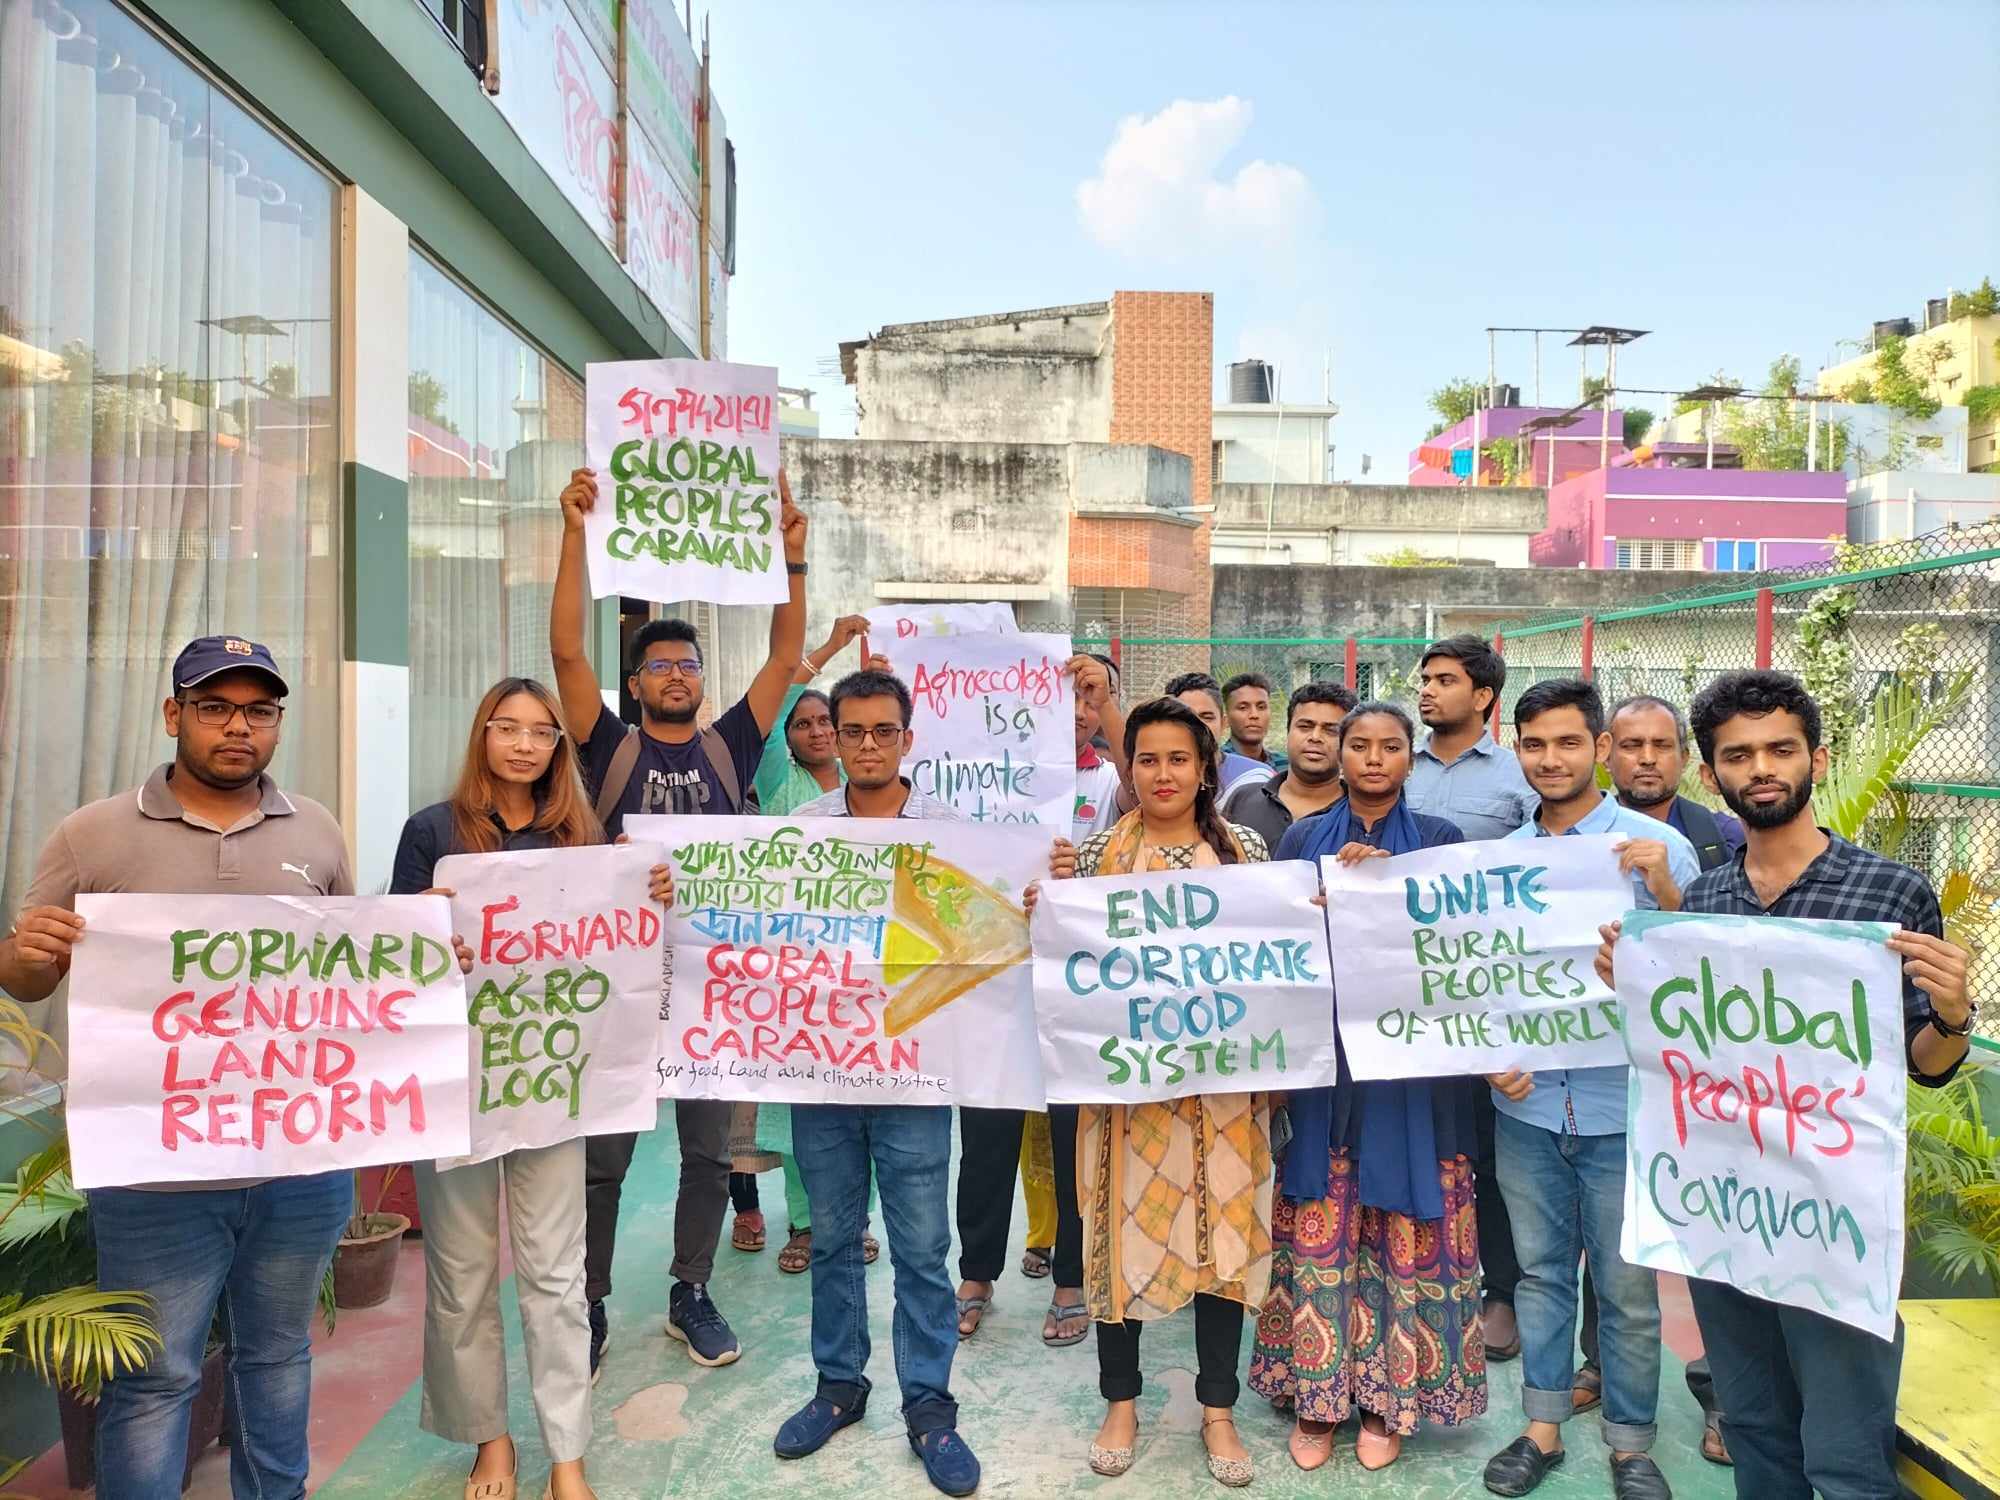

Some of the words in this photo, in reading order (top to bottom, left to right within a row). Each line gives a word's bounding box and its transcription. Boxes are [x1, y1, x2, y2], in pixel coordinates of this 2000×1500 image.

[610, 437, 769, 486] GLOBAL
[607, 527, 772, 573] CARAVAN
[984, 696, 1007, 735] is
[1013, 708, 1036, 734] a
[1105, 882, 1220, 939] END
[1405, 864, 1551, 925] UNITE
[170, 928, 452, 987] FORWARD
[481, 895, 660, 965] FORWARD
[1412, 926, 1548, 966] RURAL
[468, 963, 610, 1026] AGRO
[1065, 939, 1319, 996] CORPORATE
[1421, 958, 1586, 1006] PEOPLES
[152, 982, 416, 1043] GENUINE
[1128, 990, 1248, 1042] FOOD
[1377, 1007, 1429, 1045] OF
[1434, 1010, 1503, 1047] THE
[1650, 956, 1873, 1071] Global
[162, 1038, 356, 1092] LAND
[480, 1019, 581, 1070] ECO
[656, 1056, 684, 1088] for
[778, 1064, 815, 1080] and
[682, 1025, 920, 1072] CARAVAN
[1099, 1028, 1287, 1085] SYSTEM
[161, 1073, 426, 1152] REFORM
[478, 1053, 592, 1121] LOGY
[1648, 1151, 1866, 1263] Caravan
